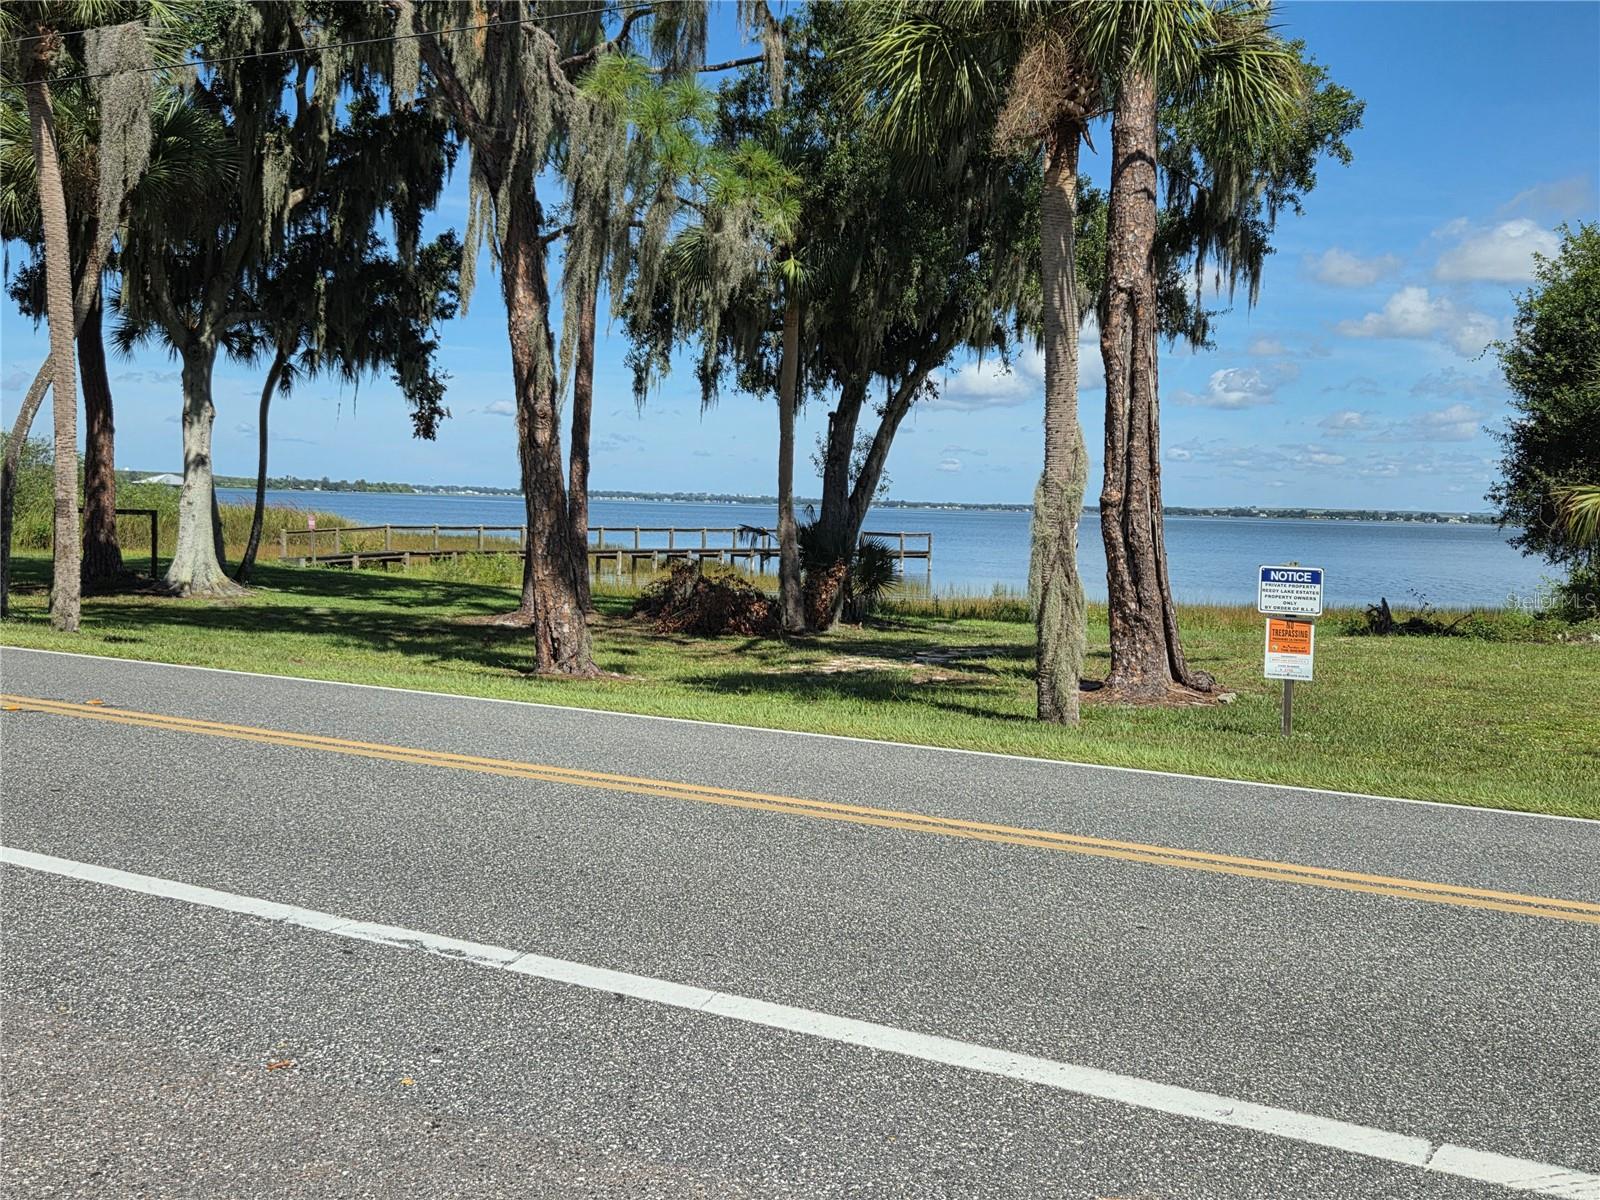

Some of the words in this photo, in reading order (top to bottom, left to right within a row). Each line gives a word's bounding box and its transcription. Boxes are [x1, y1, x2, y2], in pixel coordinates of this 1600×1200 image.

[1270, 570, 1312, 582] NOTICE
[1286, 621, 1295, 629] NO
[1271, 628, 1308, 638] TRESPASSING
